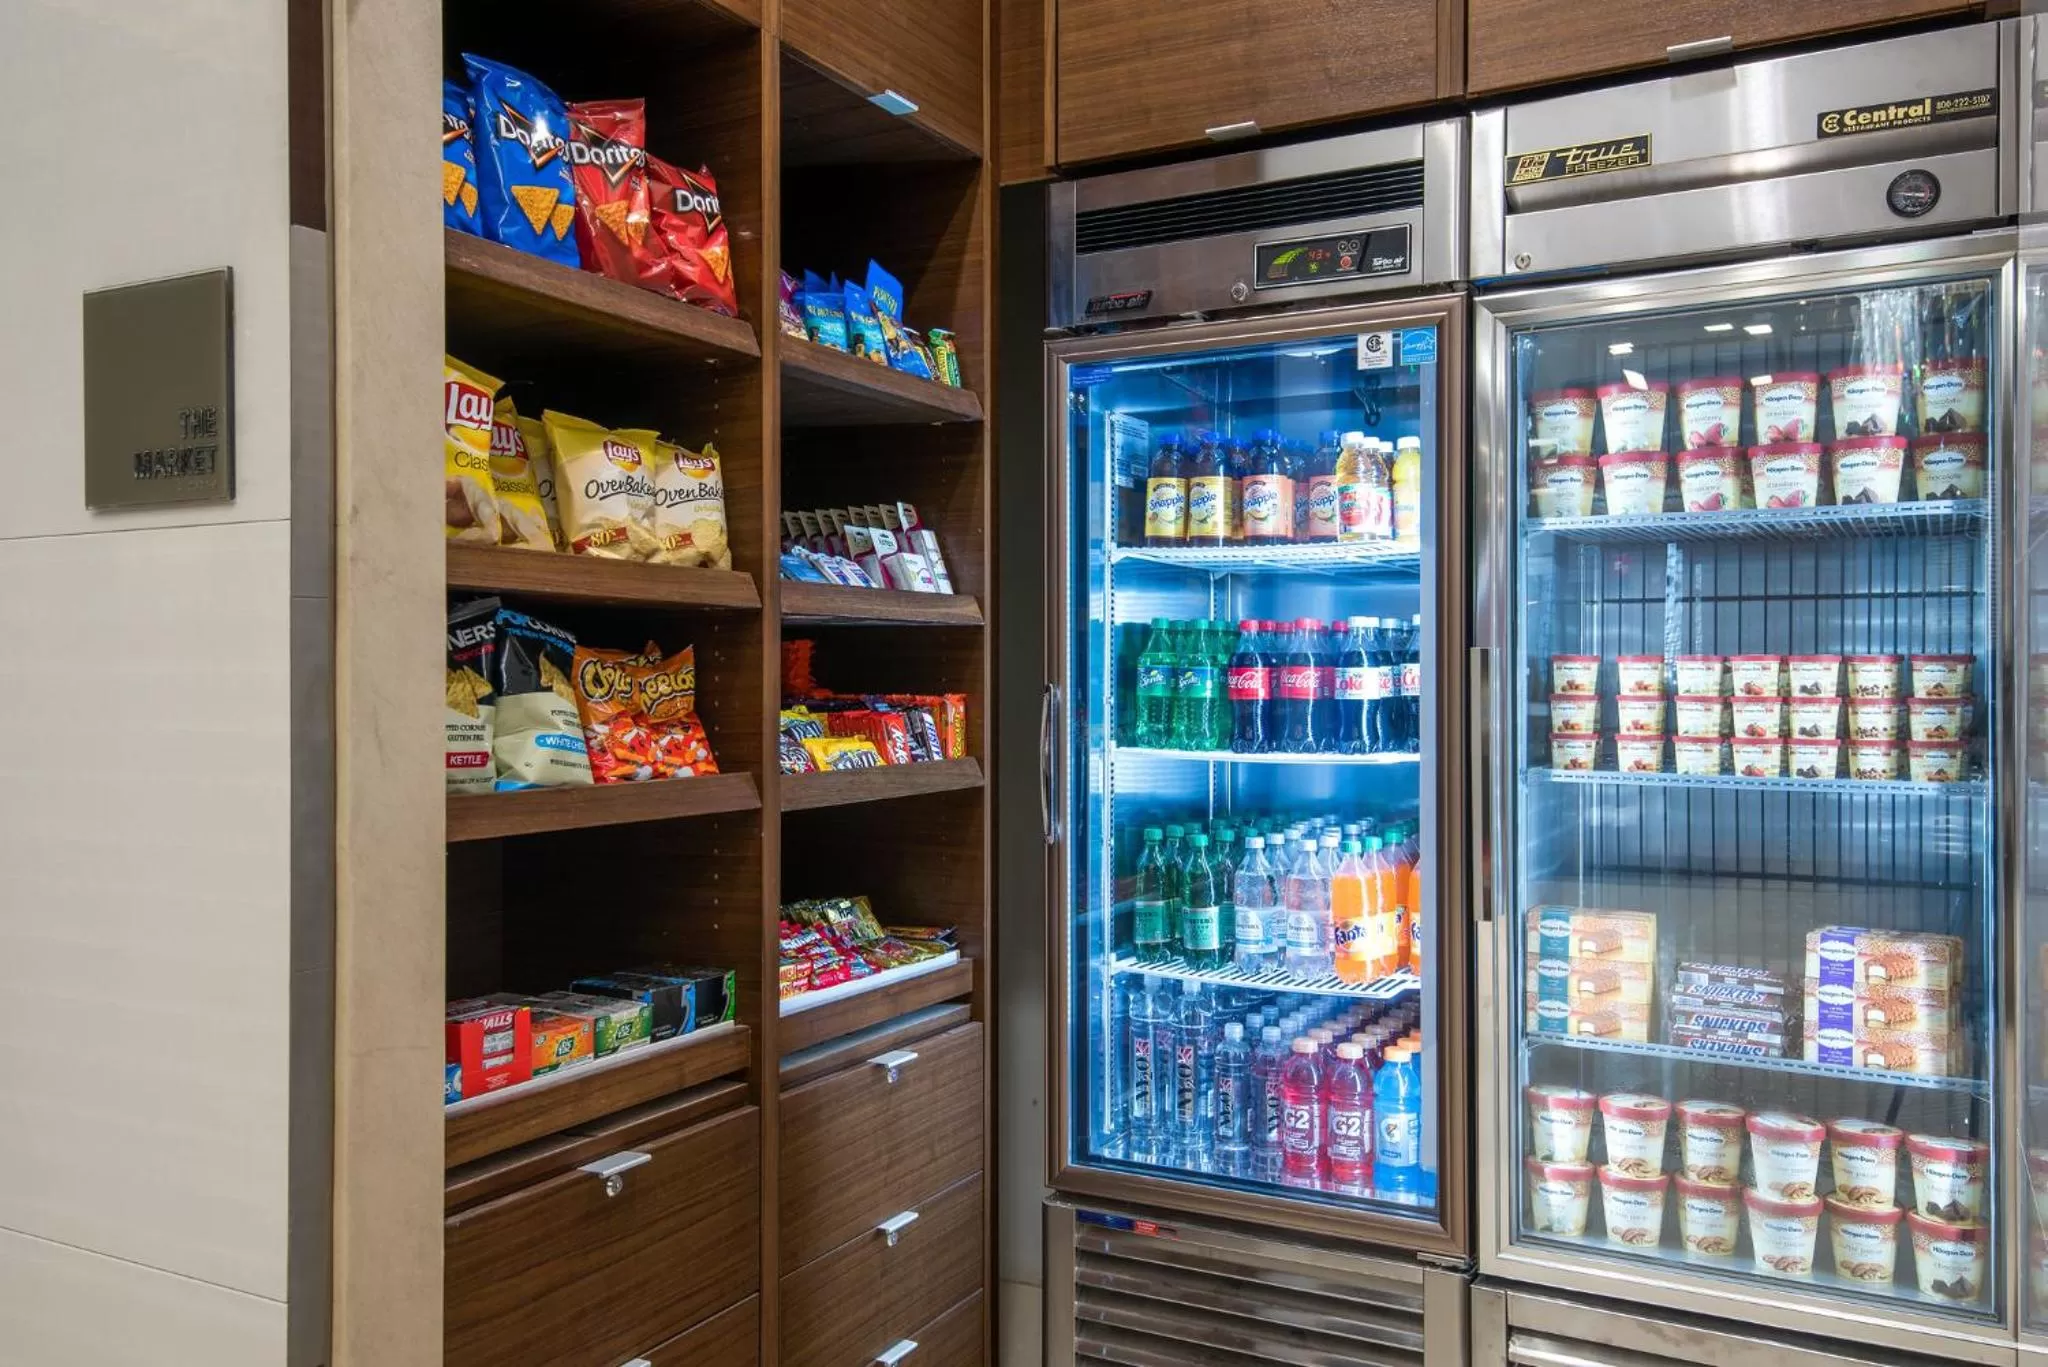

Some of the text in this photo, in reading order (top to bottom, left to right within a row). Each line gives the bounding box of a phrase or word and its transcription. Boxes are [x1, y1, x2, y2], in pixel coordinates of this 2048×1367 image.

[1844, 98, 1932, 126] Central
[1843, 116, 1932, 133] RESTAURANT PRODUCTS
[569, 140, 646, 168] Doritos
[1556, 142, 1641, 165] true
[1565, 155, 1640, 174] FREEZER
[446, 383, 493, 431] Lay
[178, 405, 217, 440] THE
[454, 451, 489, 471] Clas
[607, 442, 639, 461] Lay's
[133, 444, 217, 480] MARKET
[449, 755, 482, 765] KETTLE
[1693, 984, 1766, 1002] SNICKERS
[1692, 1015, 1769, 1033] SNICKERS
[1284, 1108, 1310, 1129] G2
[1332, 1116, 1361, 1136] G2
